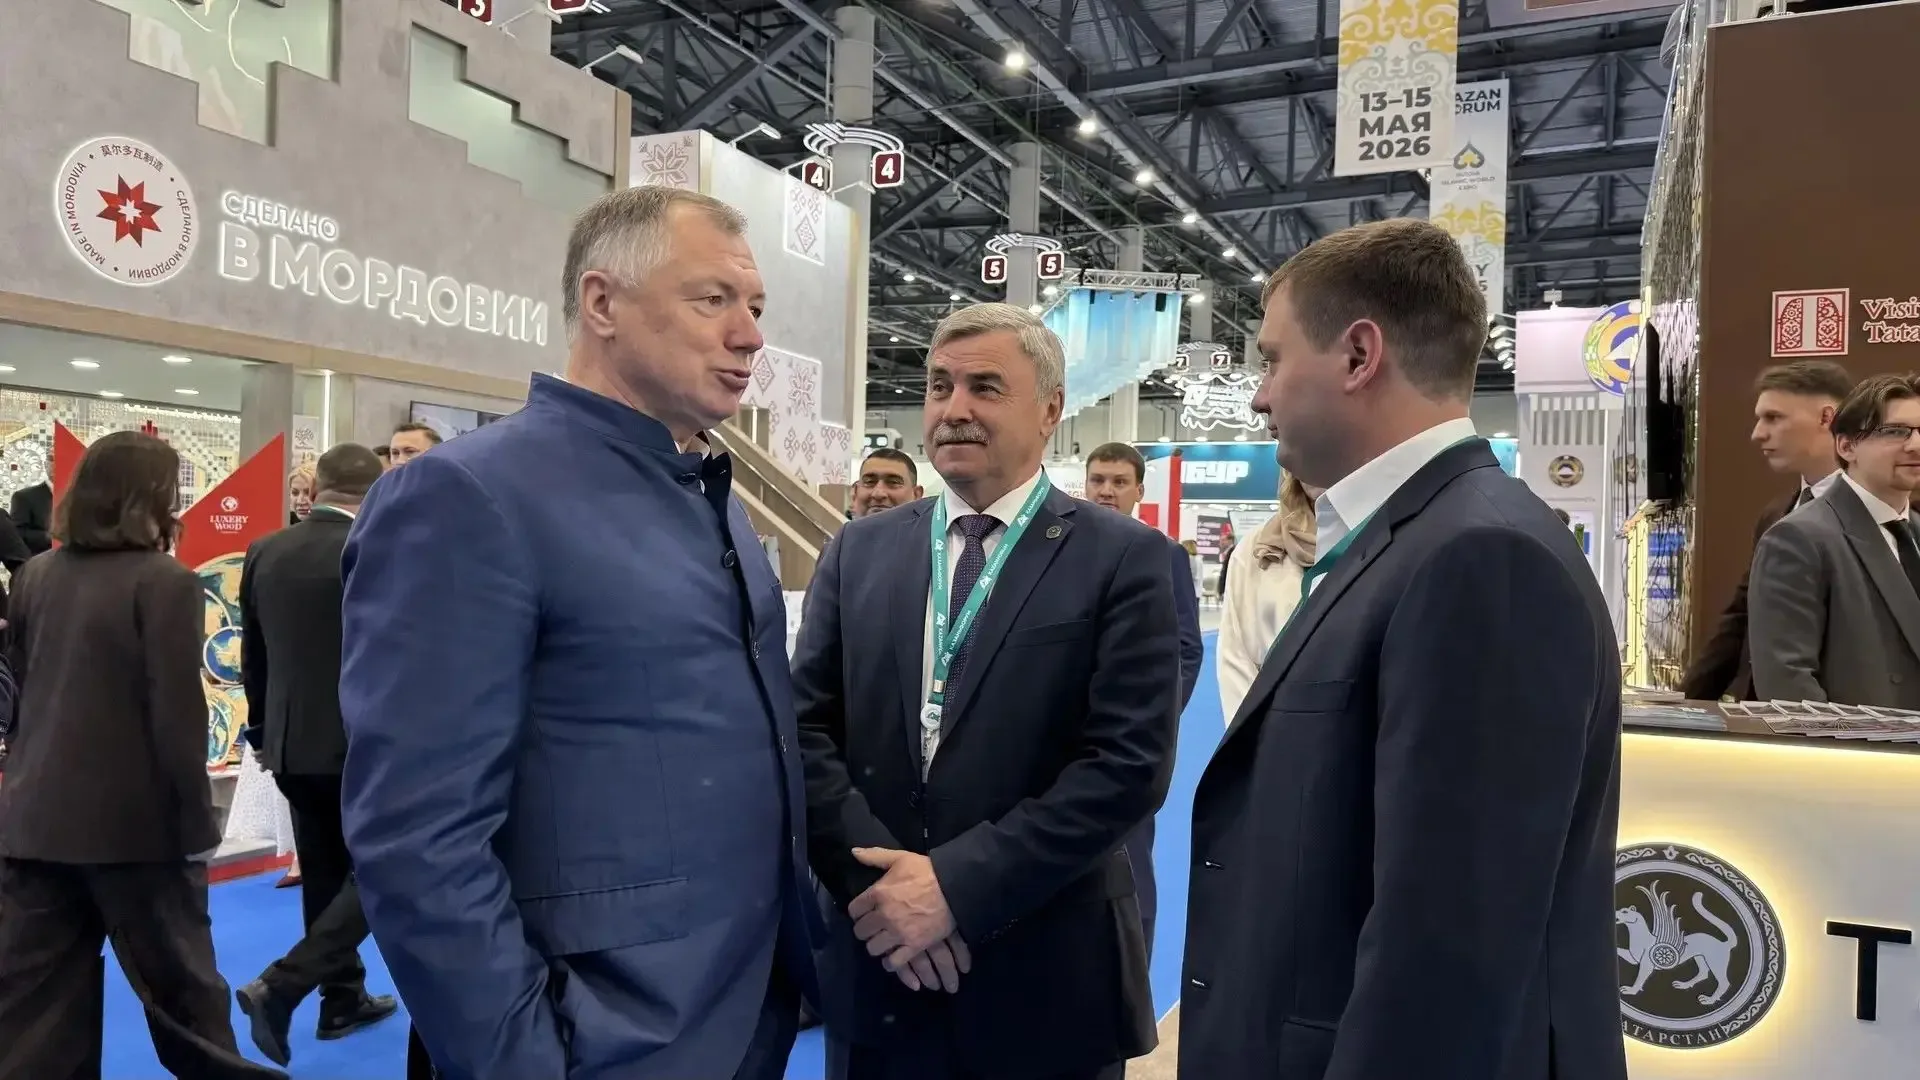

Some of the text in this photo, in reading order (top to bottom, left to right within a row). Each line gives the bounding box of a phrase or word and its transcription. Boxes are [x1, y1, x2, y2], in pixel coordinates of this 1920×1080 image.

[1359, 112, 1431, 138] МАЯ
[101, 144, 164, 172] 莫尔多瓦制造
[1358, 136, 1431, 161] 2026
[811, 167, 824, 187] 4
[881, 158, 895, 179] 4
[65, 161, 106, 265] MADE IN MORDOVIA
[221, 190, 340, 242] СДЕЛАНО
[128, 190, 192, 279] СДЕЛАНО В МОРДОВИИ
[989, 261, 1000, 278] 5
[1045, 256, 1057, 273] 5
[218, 221, 549, 347] В МОРДОВИИ
[1860, 296, 1920, 320] Visi
[1216, 355, 1226, 366] 7
[215, 522, 243, 531] WOOD
